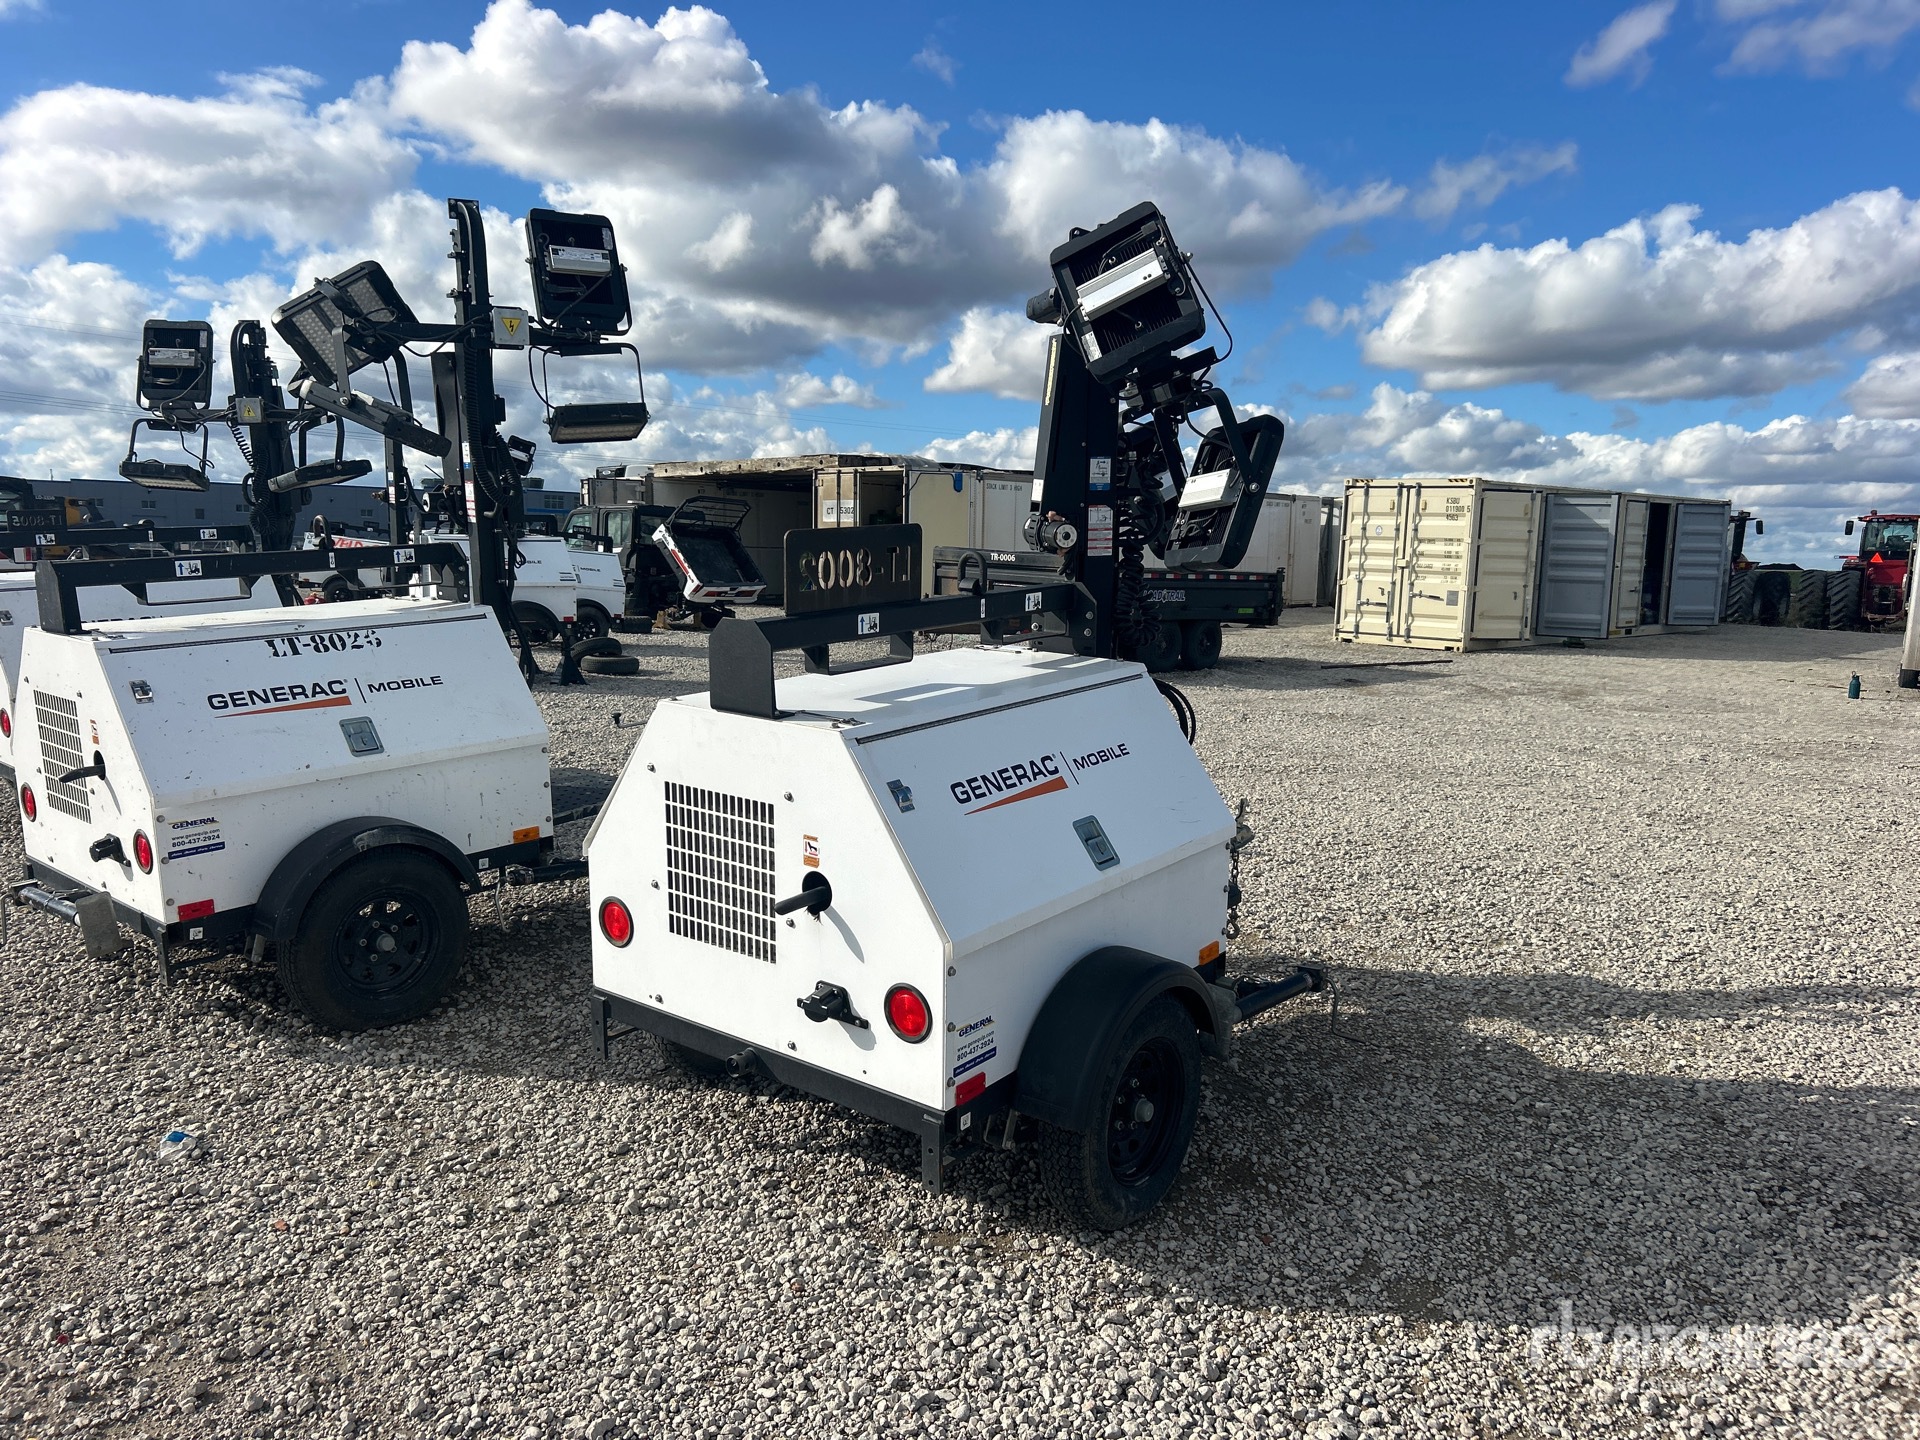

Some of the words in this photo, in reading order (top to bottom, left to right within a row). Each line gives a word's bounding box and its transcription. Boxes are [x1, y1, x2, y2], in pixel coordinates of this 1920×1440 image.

[840, 506, 855, 514] 5302
[990, 552, 1016, 561] TR-0006
[207, 679, 347, 710] GENERAC
[367, 675, 444, 694] MOBILE
[950, 755, 1060, 805] GENERAC
[1072, 743, 1130, 771] MOBILE
[172, 817, 217, 830] GENERAL
[171, 834, 221, 848] 800-437-2924
[958, 1015, 992, 1037] GENERAL
